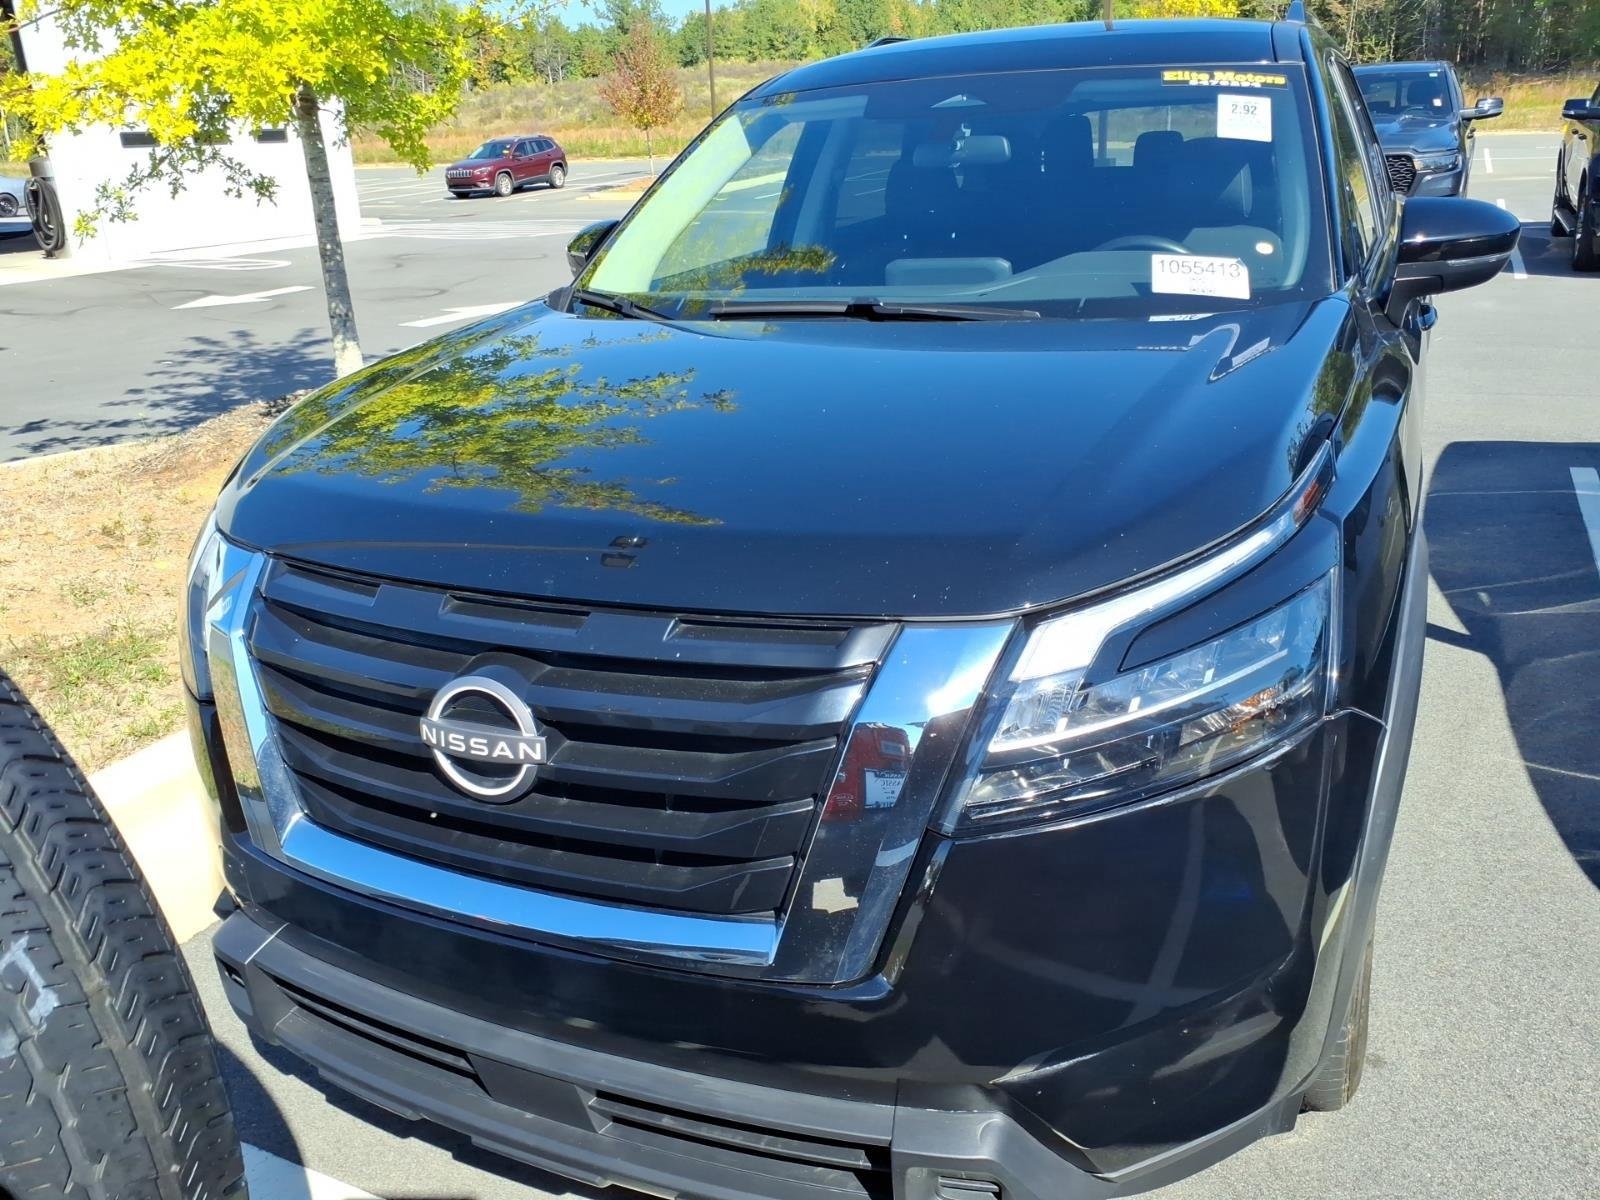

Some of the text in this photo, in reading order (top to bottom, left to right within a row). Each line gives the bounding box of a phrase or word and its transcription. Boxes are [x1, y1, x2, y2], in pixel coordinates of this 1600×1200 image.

[1163, 71, 1210, 81] Elite
[1213, 71, 1286, 85] Motors
[1158, 259, 1241, 278] 1055413
[421, 724, 542, 760] NISSAN
